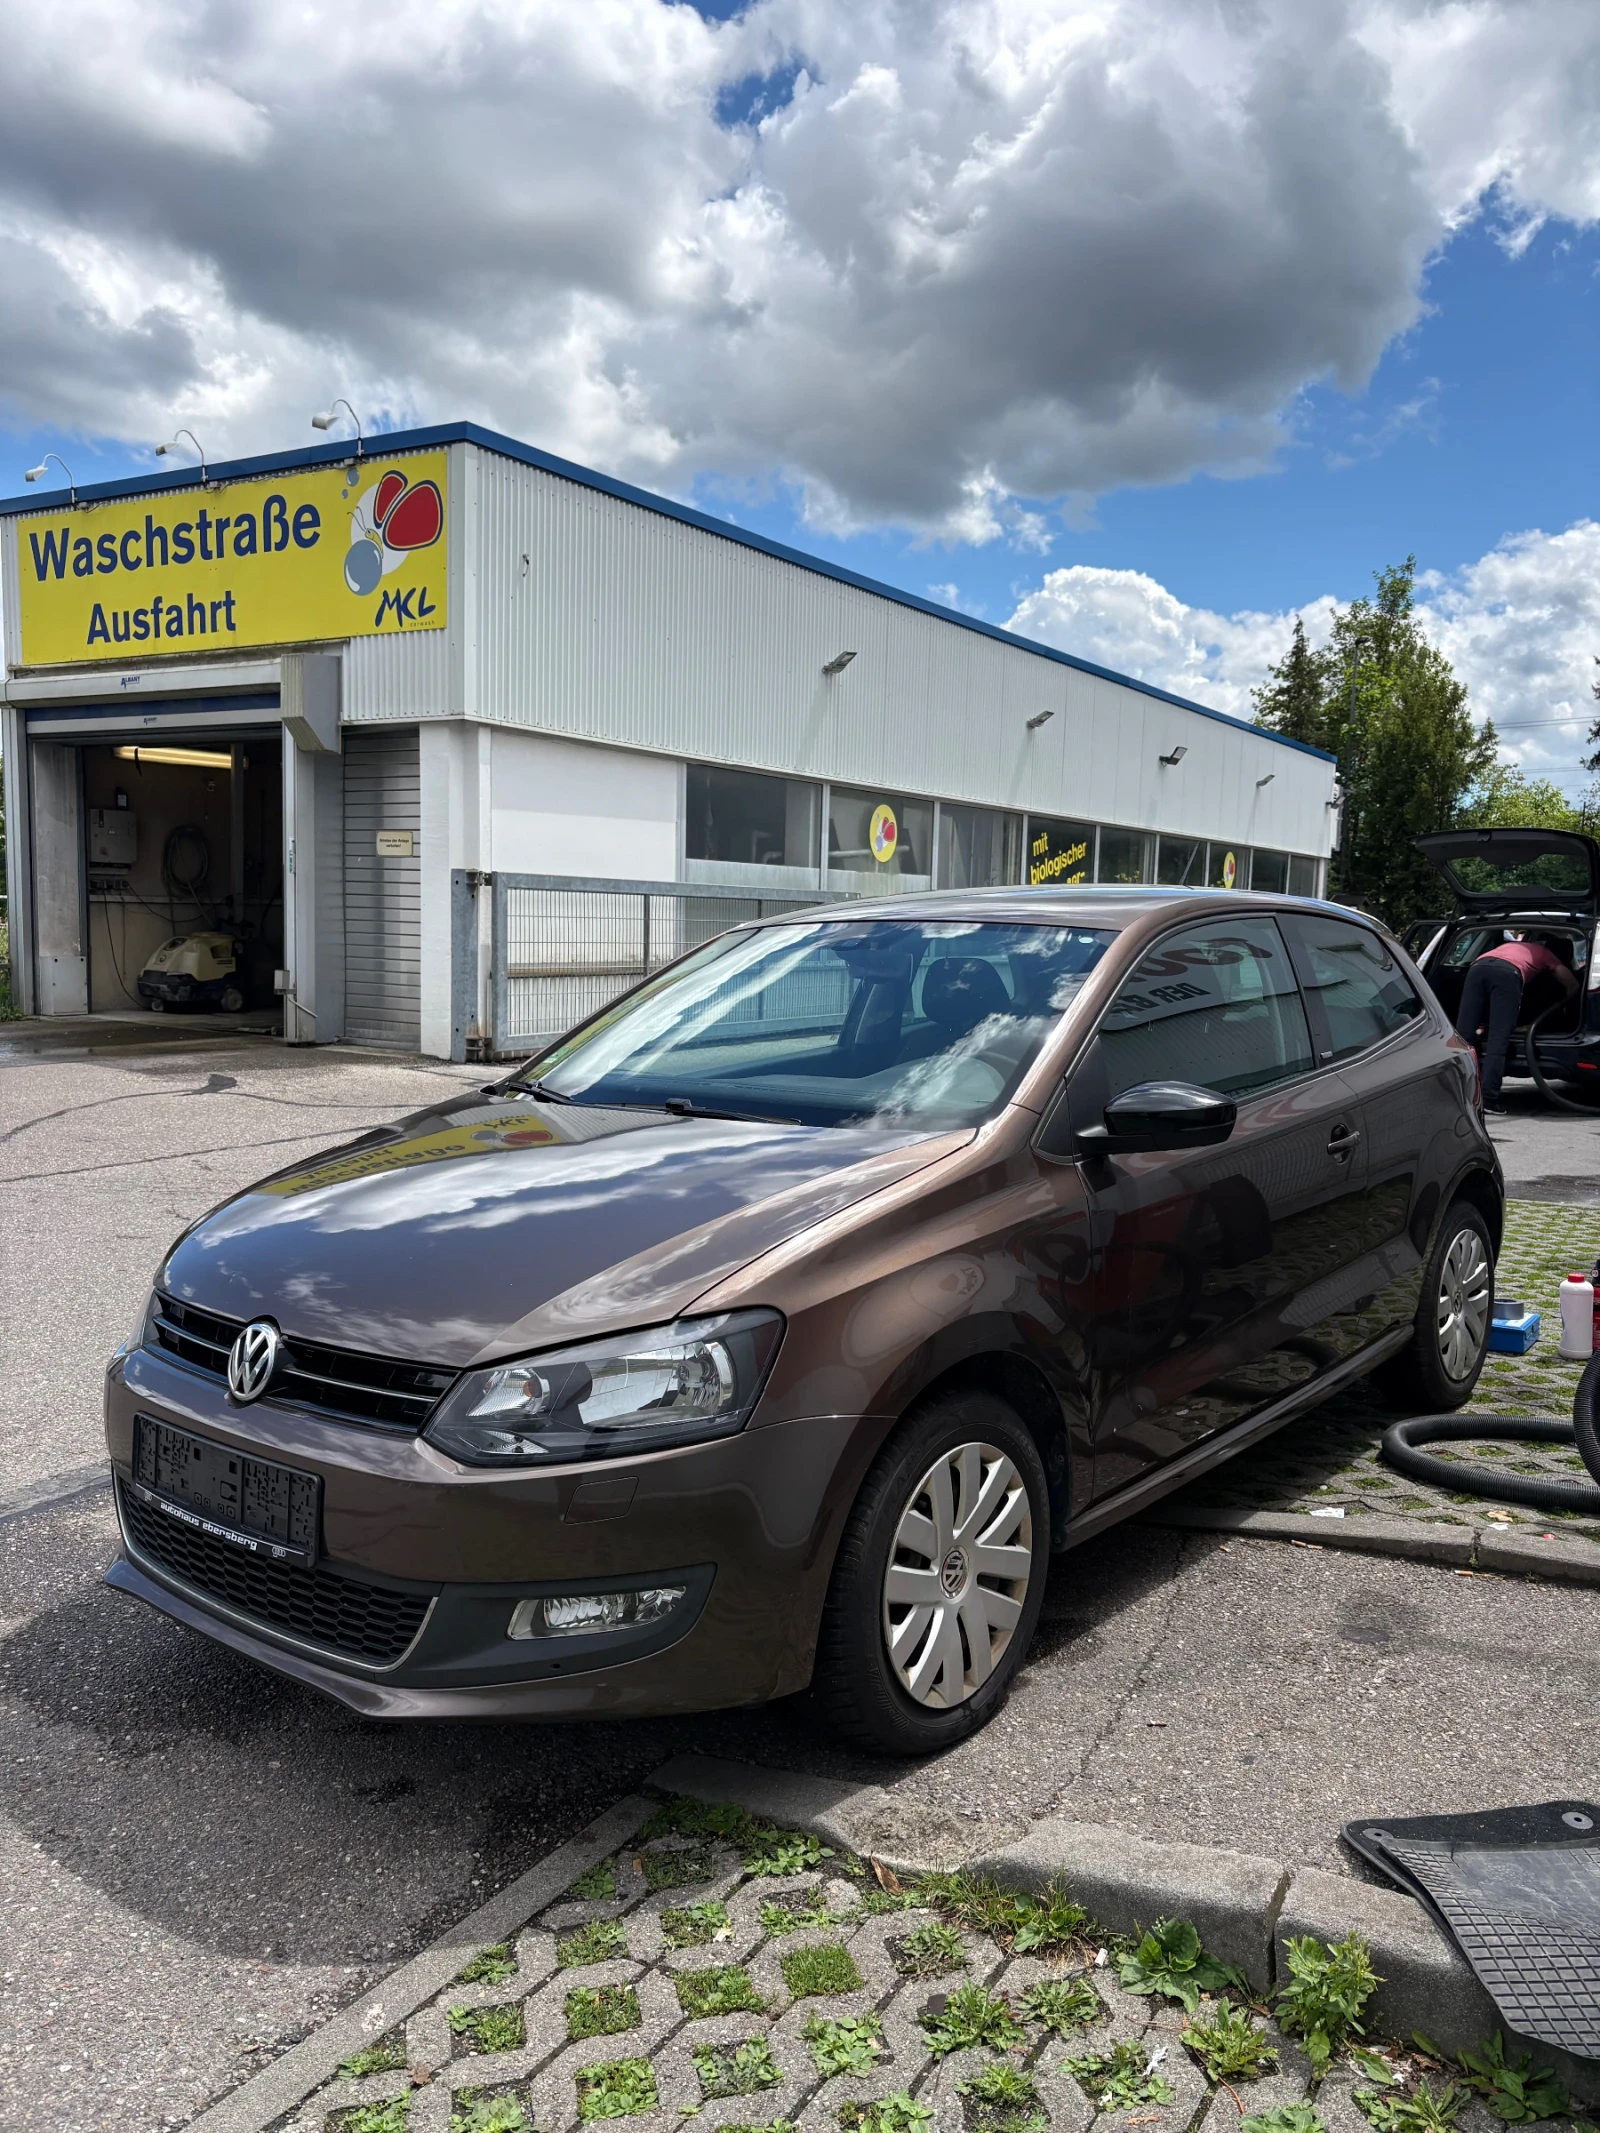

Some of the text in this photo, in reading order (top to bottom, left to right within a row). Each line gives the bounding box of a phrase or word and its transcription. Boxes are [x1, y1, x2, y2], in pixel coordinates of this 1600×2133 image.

[29, 494, 321, 582] Waschstraße
[87, 590, 236, 645] Ausfahrt
[1030, 842, 1087, 885] biologischer
[1032, 832, 1049, 857] mit
[227, 1323, 280, 1402] VW
[160, 1501, 258, 1551] autohaus ebersberg
